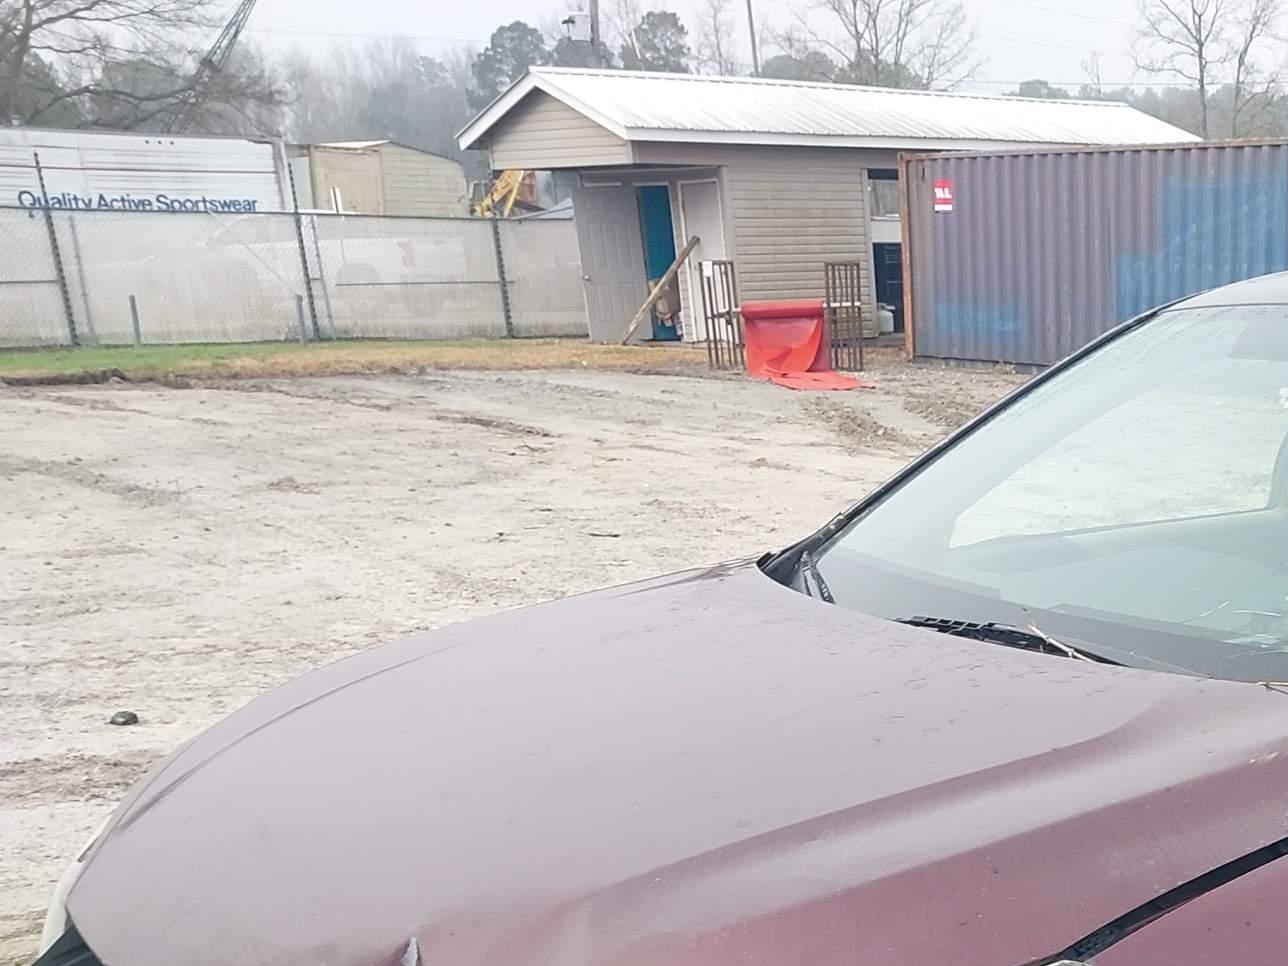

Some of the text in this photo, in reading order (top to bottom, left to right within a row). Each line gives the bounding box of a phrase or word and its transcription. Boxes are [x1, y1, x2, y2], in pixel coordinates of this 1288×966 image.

[18, 190, 258, 212] Quality Active Sportswear
